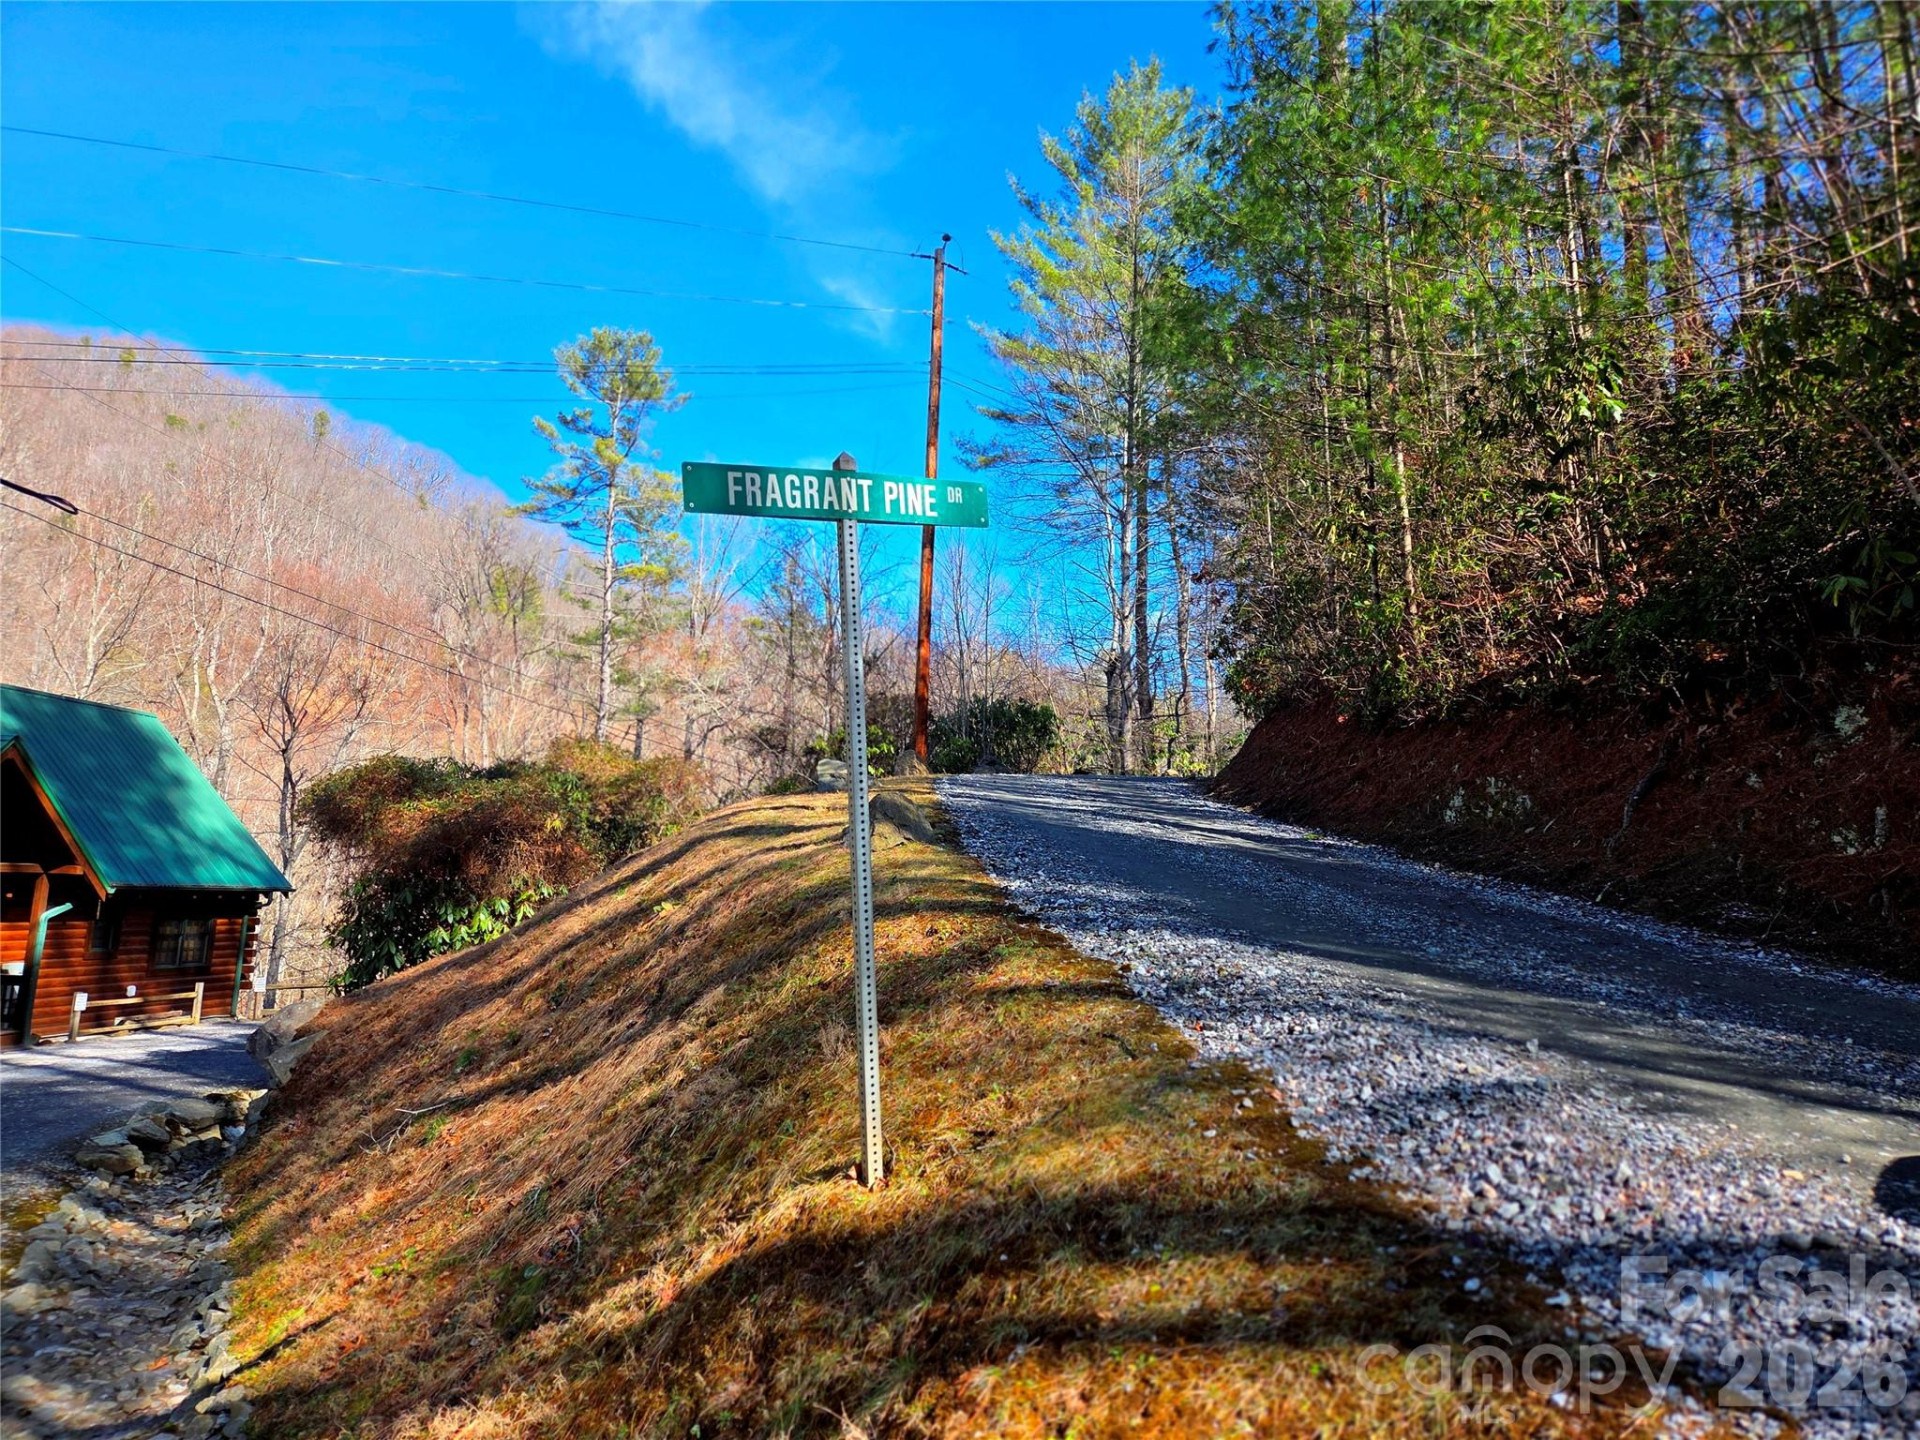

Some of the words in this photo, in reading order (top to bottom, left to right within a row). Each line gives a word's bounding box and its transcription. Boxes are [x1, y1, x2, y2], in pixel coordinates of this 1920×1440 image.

[727, 471, 873, 512] FRAGRANT
[884, 481, 938, 517] PINE
[947, 486, 963, 504] DR
